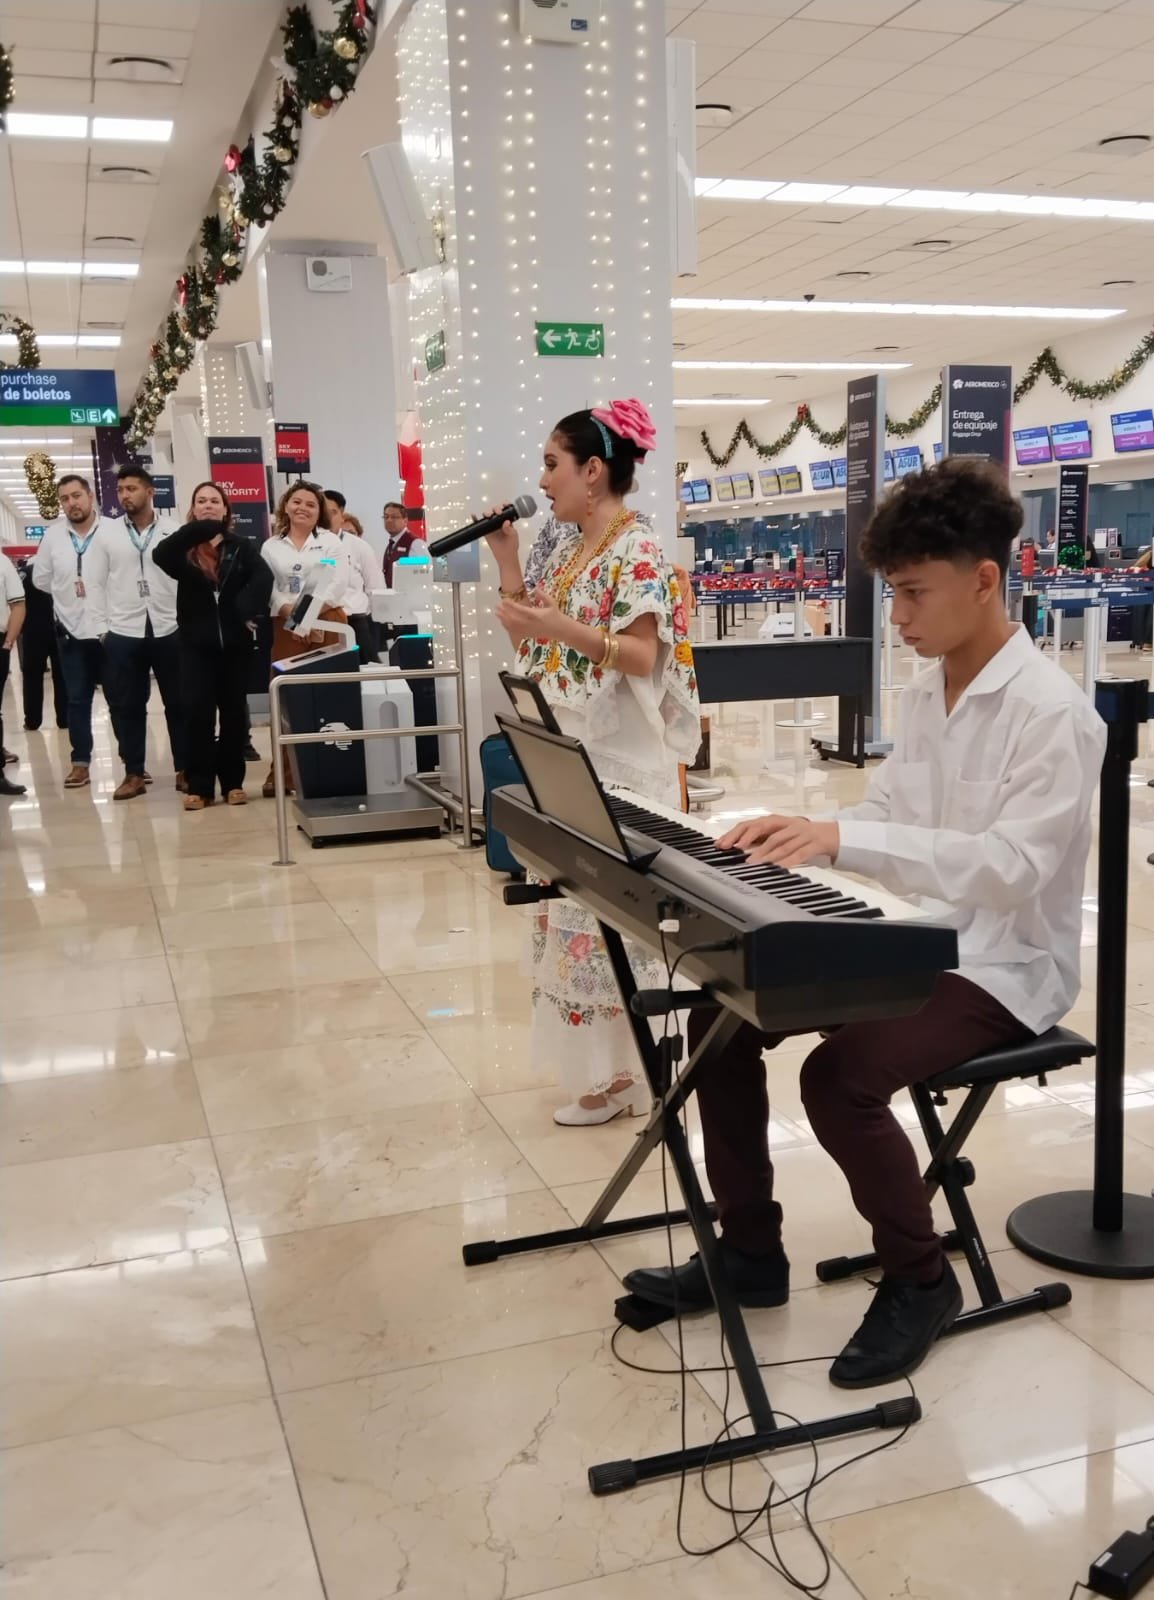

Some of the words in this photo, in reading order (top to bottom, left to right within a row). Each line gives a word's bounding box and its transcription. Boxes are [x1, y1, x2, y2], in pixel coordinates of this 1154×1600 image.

[1, 372, 57, 387] purchase
[4, 387, 20, 400] de
[23, 387, 71, 400] boletos
[952, 410, 984, 420] Entrega
[952, 420, 963, 429] de
[964, 420, 998, 431] equipaje
[898, 456, 918, 469] ASUR
[223, 488, 260, 496] RIORITY
